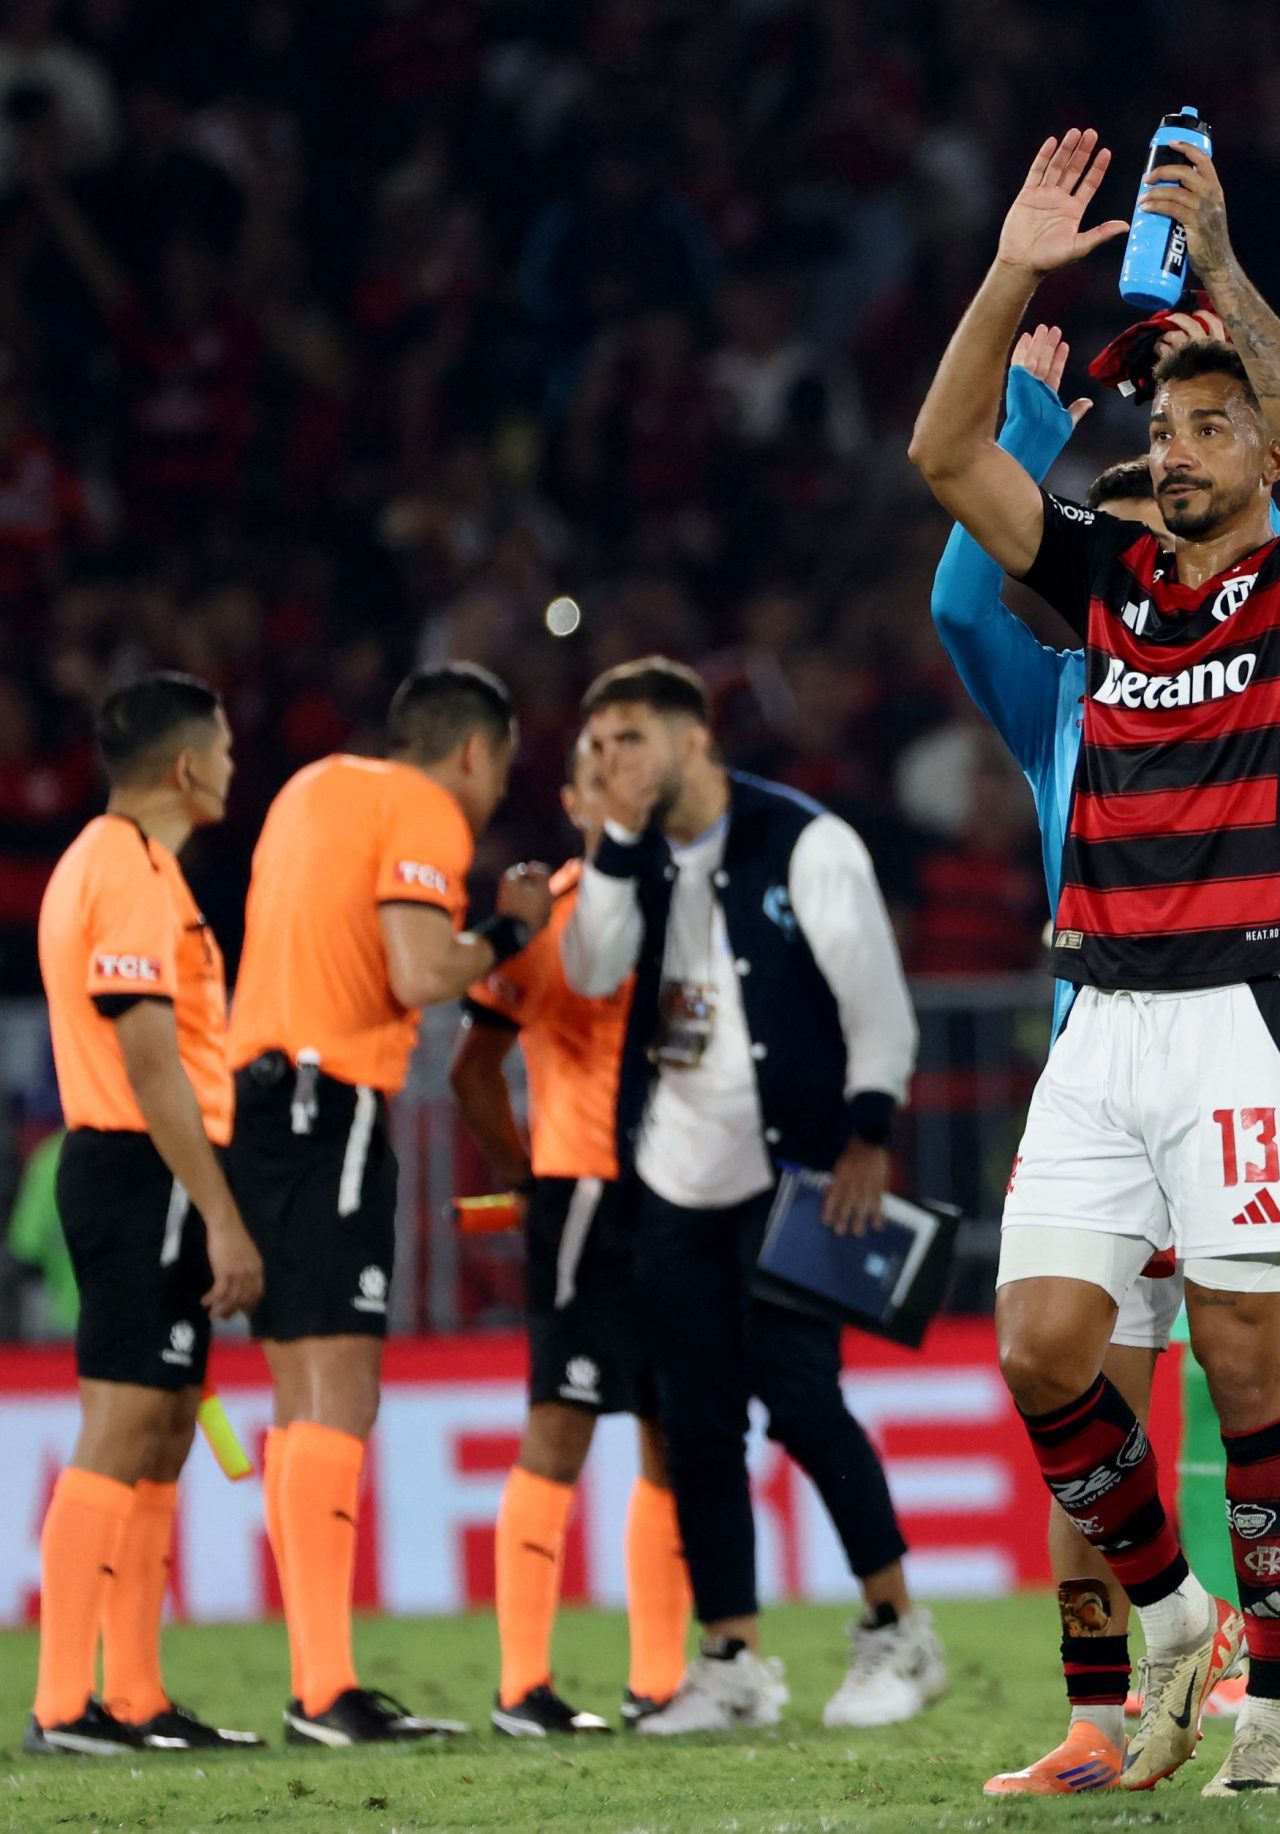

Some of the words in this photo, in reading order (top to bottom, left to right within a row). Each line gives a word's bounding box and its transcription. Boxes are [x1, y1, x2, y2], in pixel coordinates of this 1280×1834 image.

[1092, 653, 1256, 709] Betano
[97, 954, 158, 981] TCL
[1212, 1107, 1280, 1187] 13
